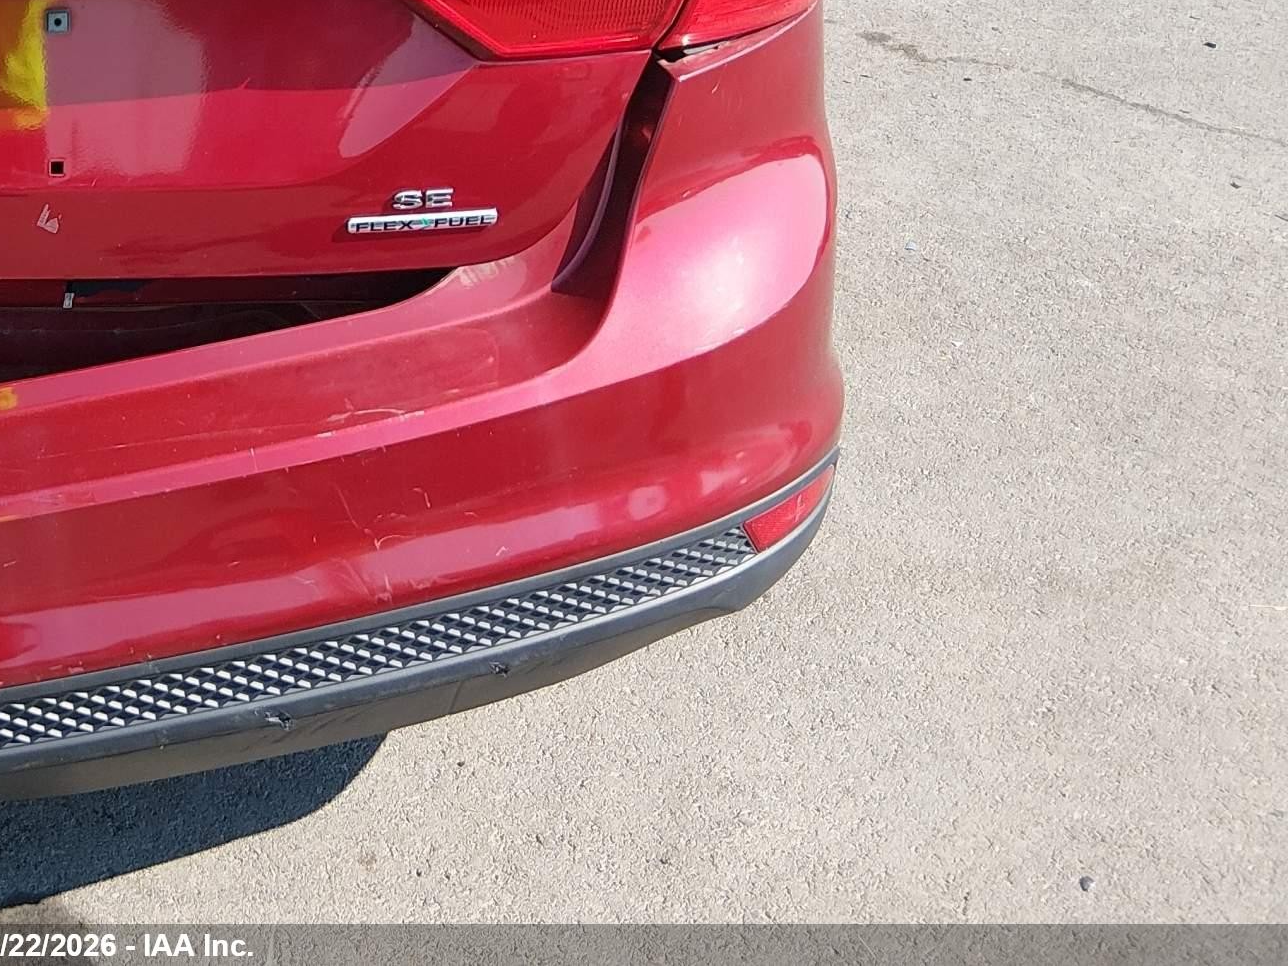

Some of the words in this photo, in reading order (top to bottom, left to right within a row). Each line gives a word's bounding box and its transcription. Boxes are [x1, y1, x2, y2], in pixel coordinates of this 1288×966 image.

[392, 187, 455, 211] SE
[354, 219, 414, 233] FLEX
[433, 213, 496, 228] FUEL
